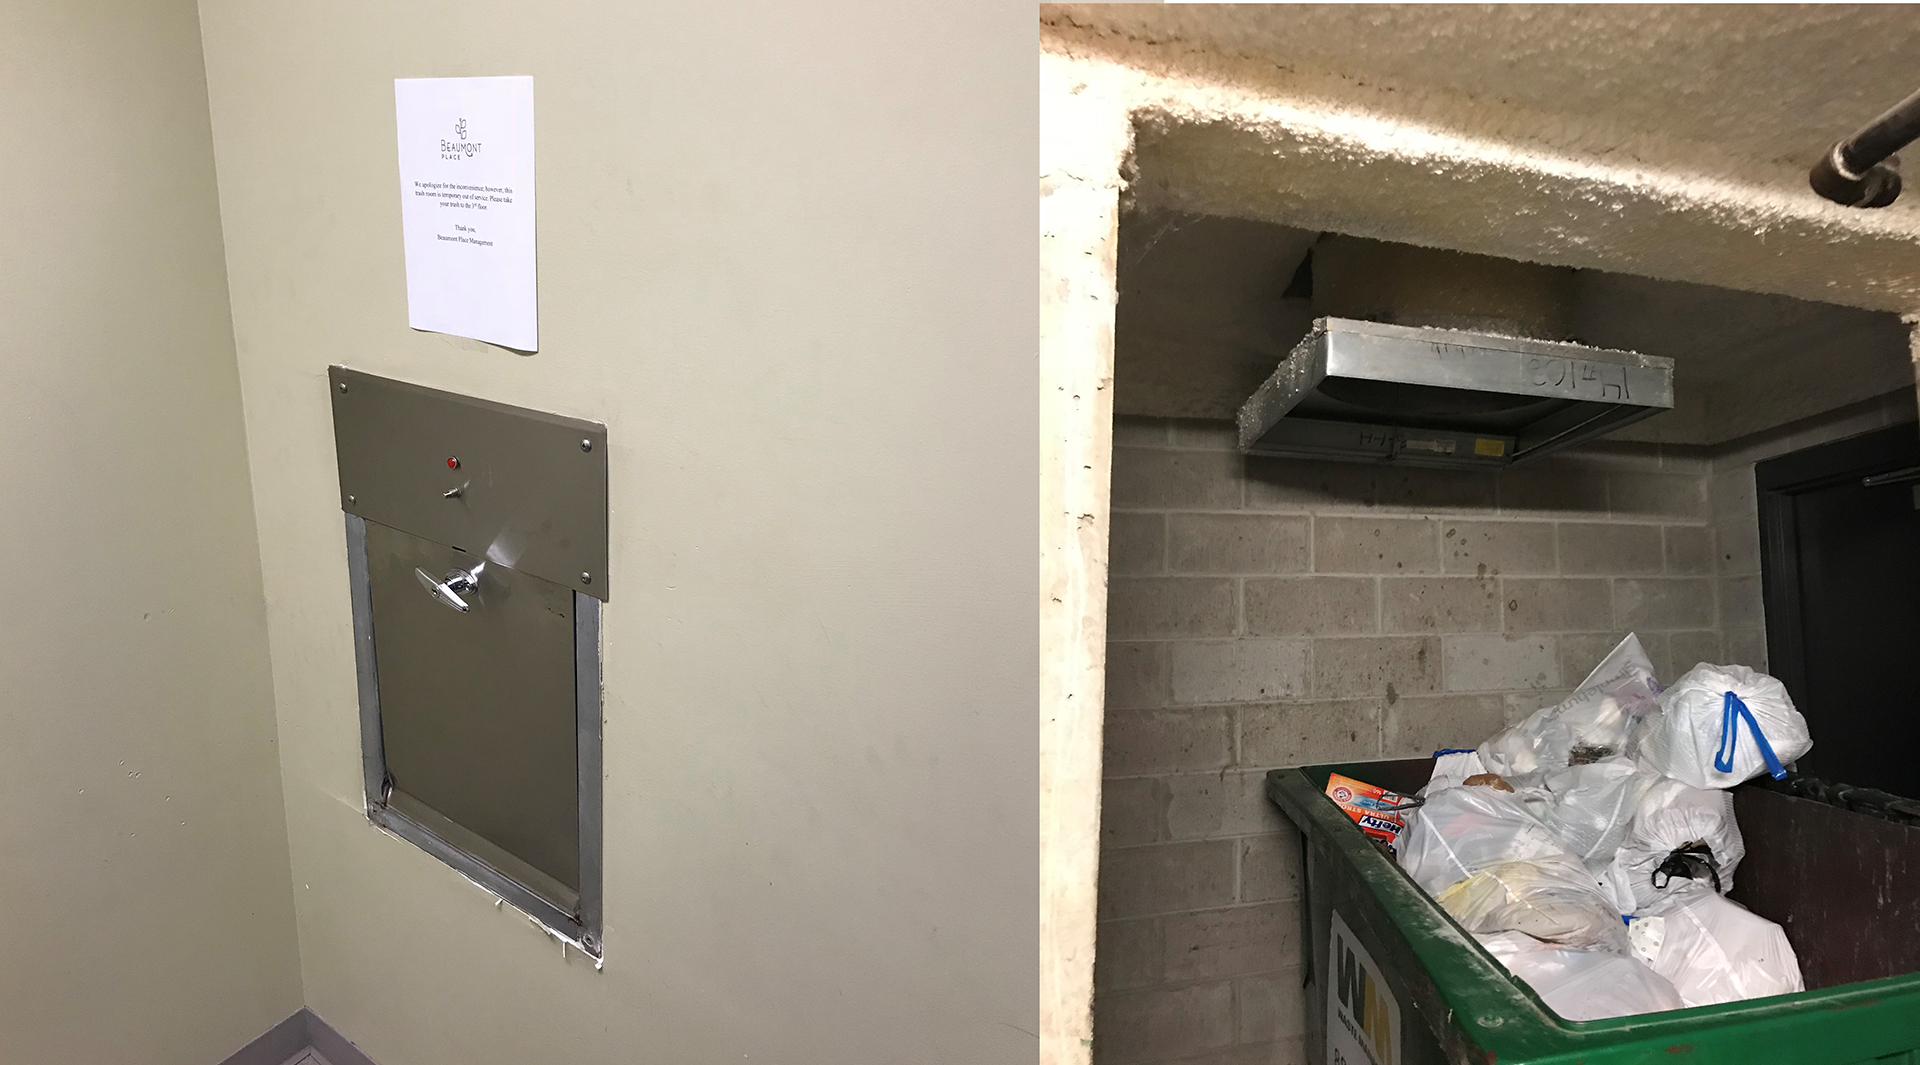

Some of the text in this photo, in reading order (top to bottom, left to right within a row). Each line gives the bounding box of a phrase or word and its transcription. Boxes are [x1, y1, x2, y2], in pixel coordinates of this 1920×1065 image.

[440, 139, 482, 157] BEAUMONT
[422, 182, 442, 190] apologize
[455, 224, 467, 232] Thank
[437, 234, 458, 242] Beaumont
[469, 238, 493, 246] Management
[1364, 809, 1390, 820] ULTRA
[1362, 816, 1401, 835] Hefty
[1338, 1006, 1358, 1041] WASTE
